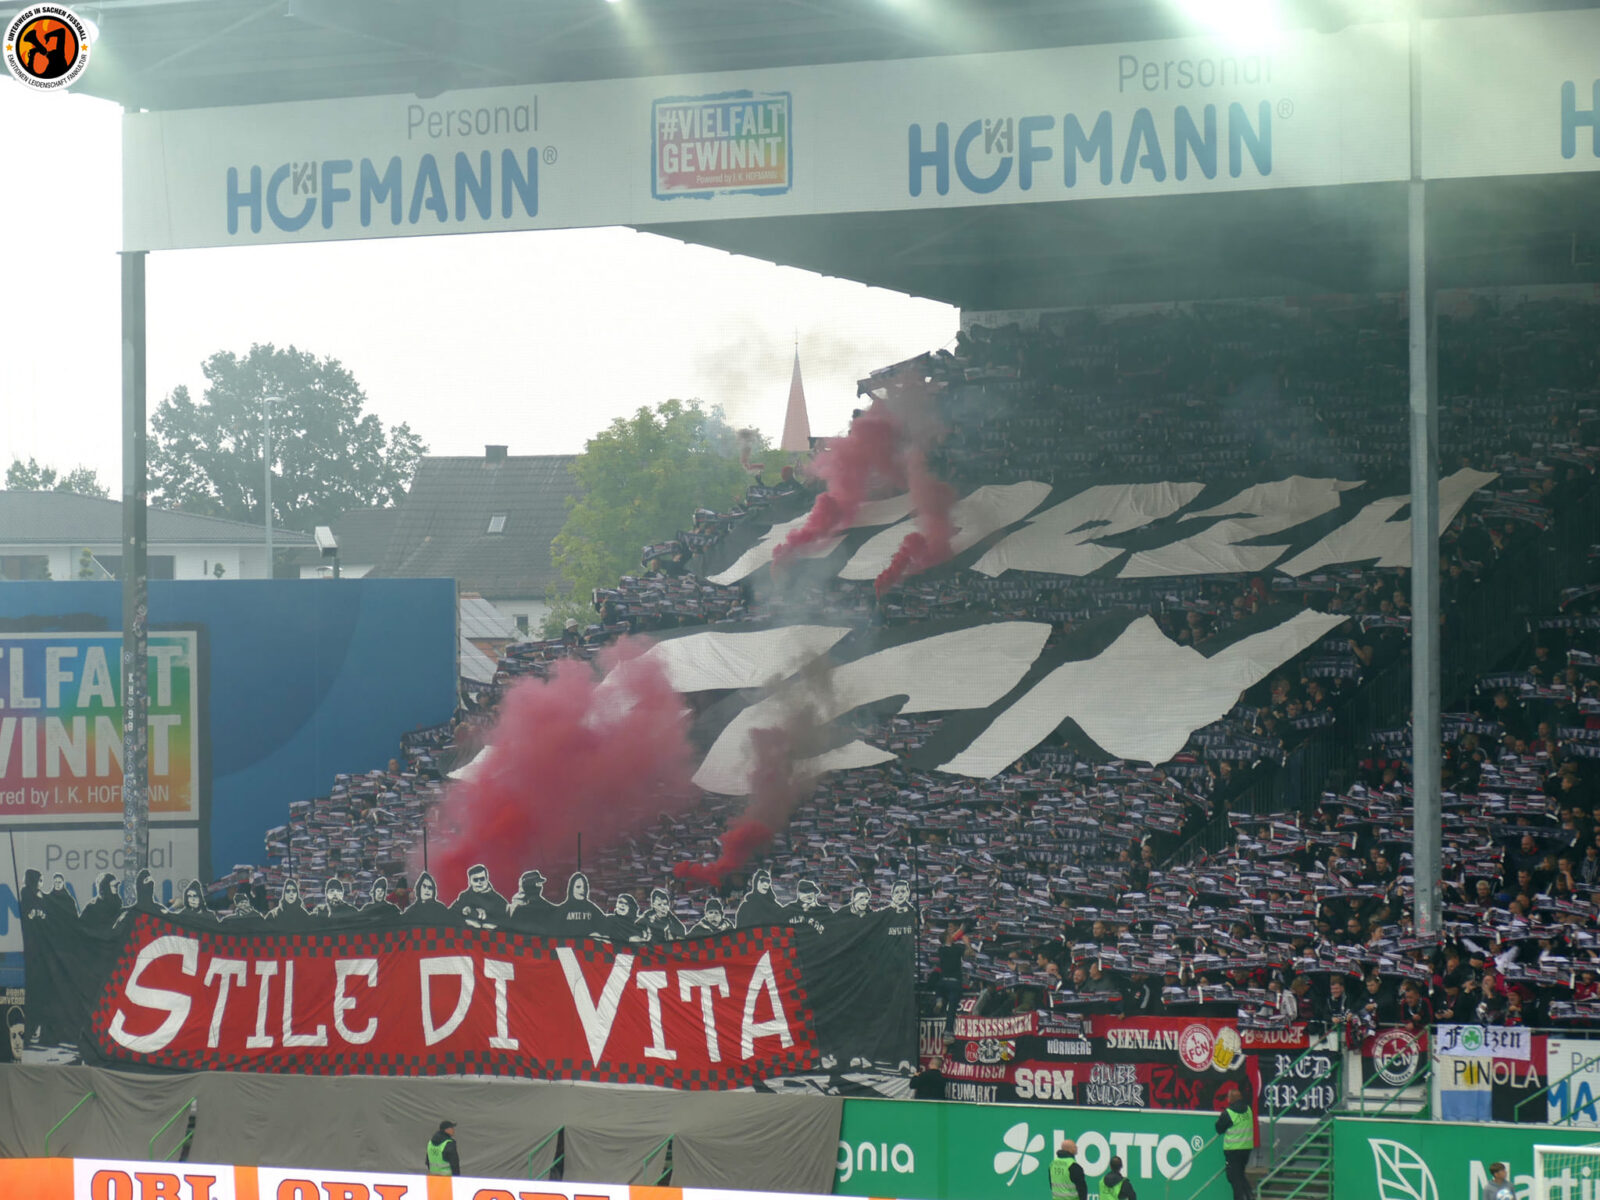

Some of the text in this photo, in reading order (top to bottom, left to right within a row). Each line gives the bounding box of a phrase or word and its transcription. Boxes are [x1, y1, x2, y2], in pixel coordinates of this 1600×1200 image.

[407, 94, 538, 140] Personal
[661, 103, 782, 140] #VIELFALT
[663, 136, 782, 173] GEWINNT
[31, 789, 49, 808] by
[108, 935, 795, 1067] STILE DI VITA
[1189, 1041, 1209, 1061] FCN
[1275, 1054, 1332, 1079] RED
[1015, 1067, 1075, 1100] SGN
[1453, 1060, 1541, 1088] PINOLA
